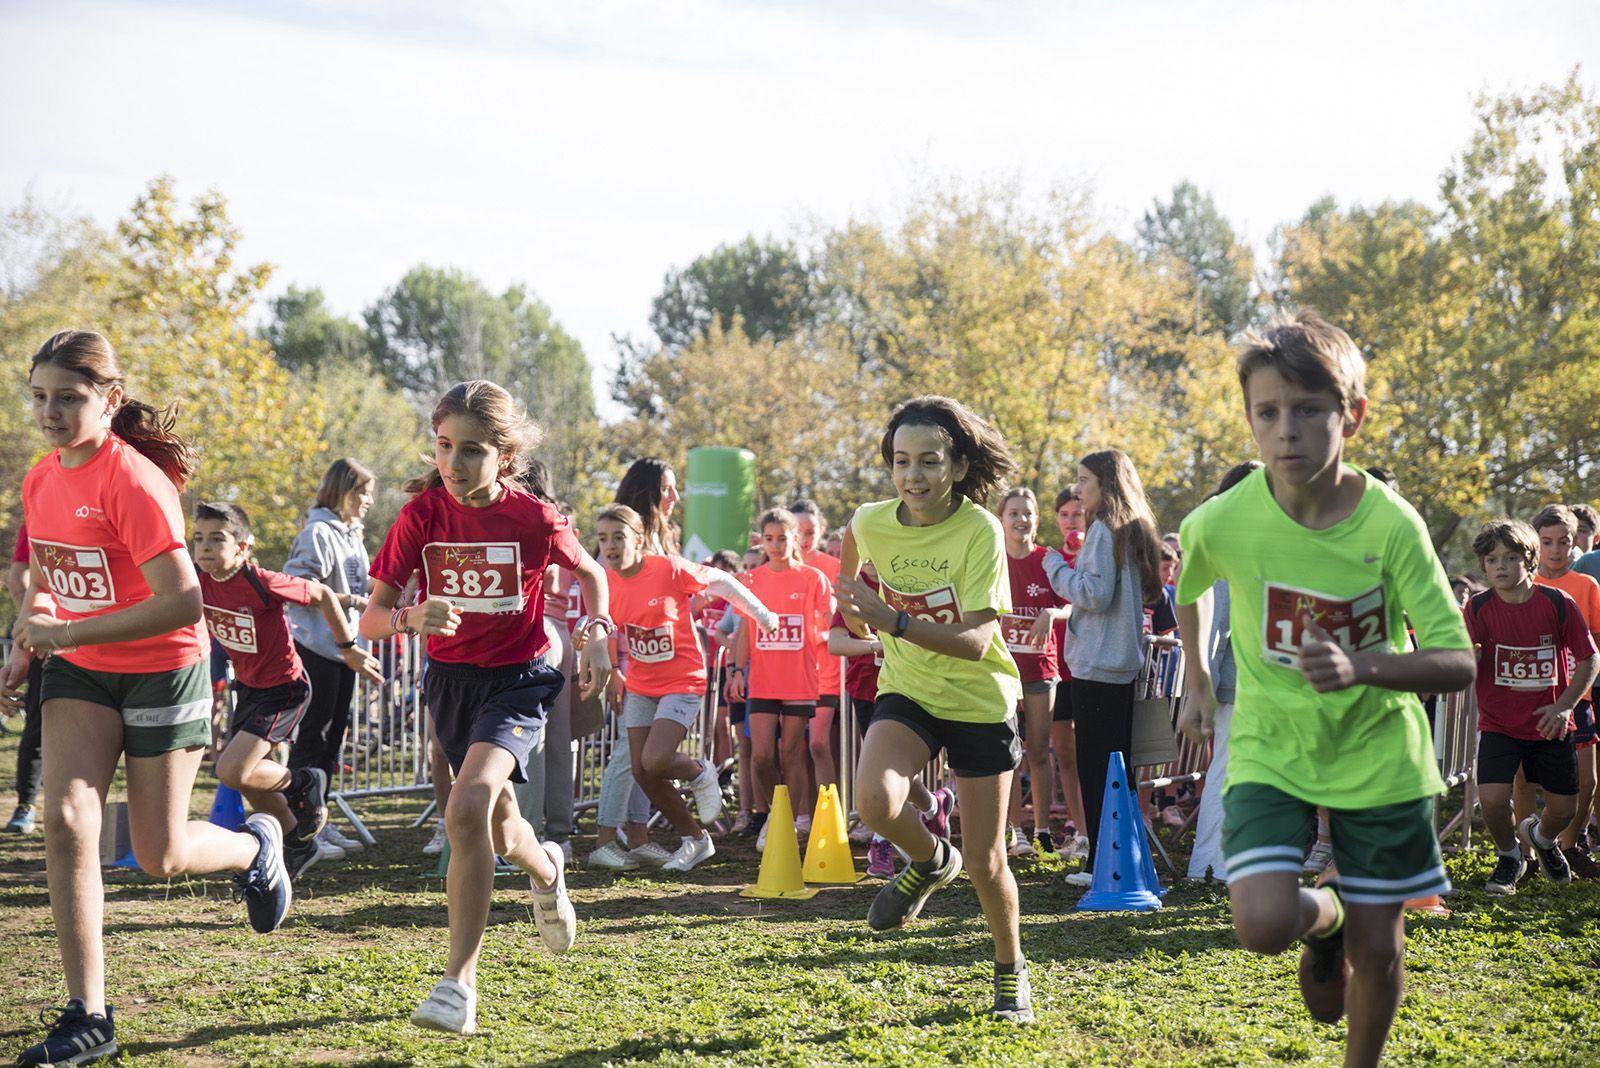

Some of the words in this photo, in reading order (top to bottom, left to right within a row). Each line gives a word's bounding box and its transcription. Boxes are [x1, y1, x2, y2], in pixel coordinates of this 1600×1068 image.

[890, 554, 950, 578] ESCOLA
[42, 566, 107, 599] 1003
[441, 569, 504, 597] 382
[207, 619, 253, 644] 1616
[759, 627, 801, 642] 1011
[1008, 628, 1031, 644] 37
[1275, 615, 1382, 652] 112
[629, 637, 671, 655] 1006
[1500, 661, 1554, 679] 1619
